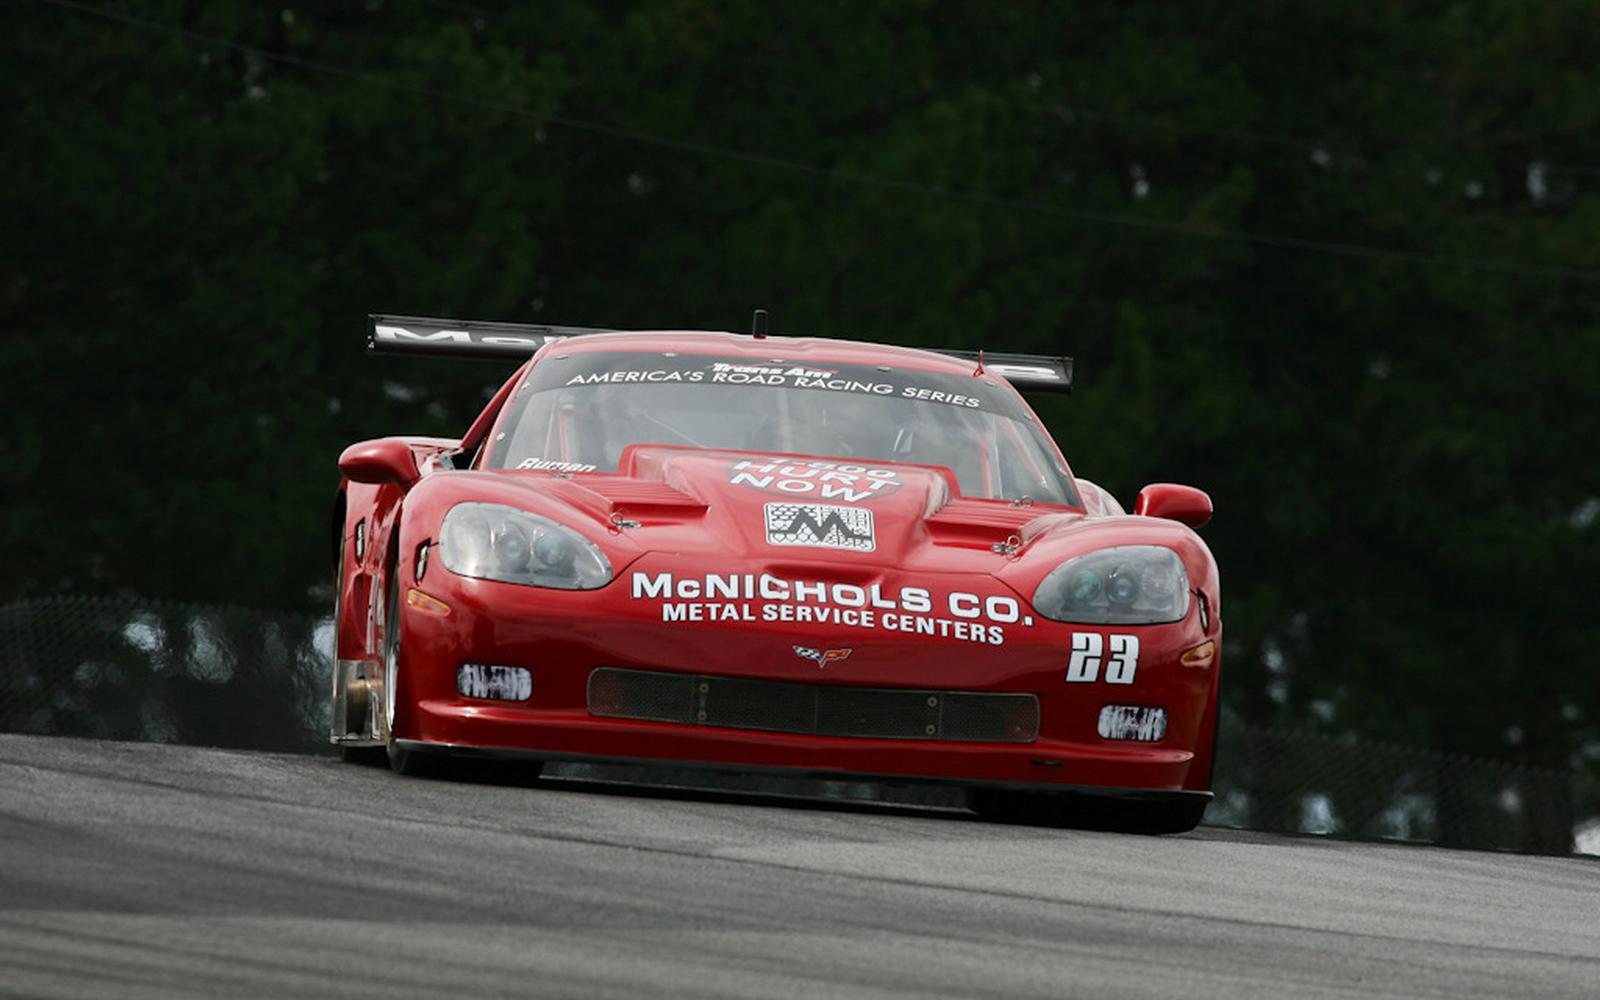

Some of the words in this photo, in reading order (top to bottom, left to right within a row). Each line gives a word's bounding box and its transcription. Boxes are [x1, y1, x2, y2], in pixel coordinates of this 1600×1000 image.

[566, 371, 704, 387] AMERICA'S
[712, 372, 785, 385] ROAD
[794, 378, 894, 394] RACING
[902, 387, 981, 408] SERIES
[730, 472, 873, 503] NOW
[732, 460, 902, 490] HURT
[662, 603, 756, 622] METAL
[762, 606, 875, 628] SERVICE
[882, 613, 1005, 645] CENTERS
[948, 591, 1034, 626] CO.
[1065, 631, 1140, 685] 23
